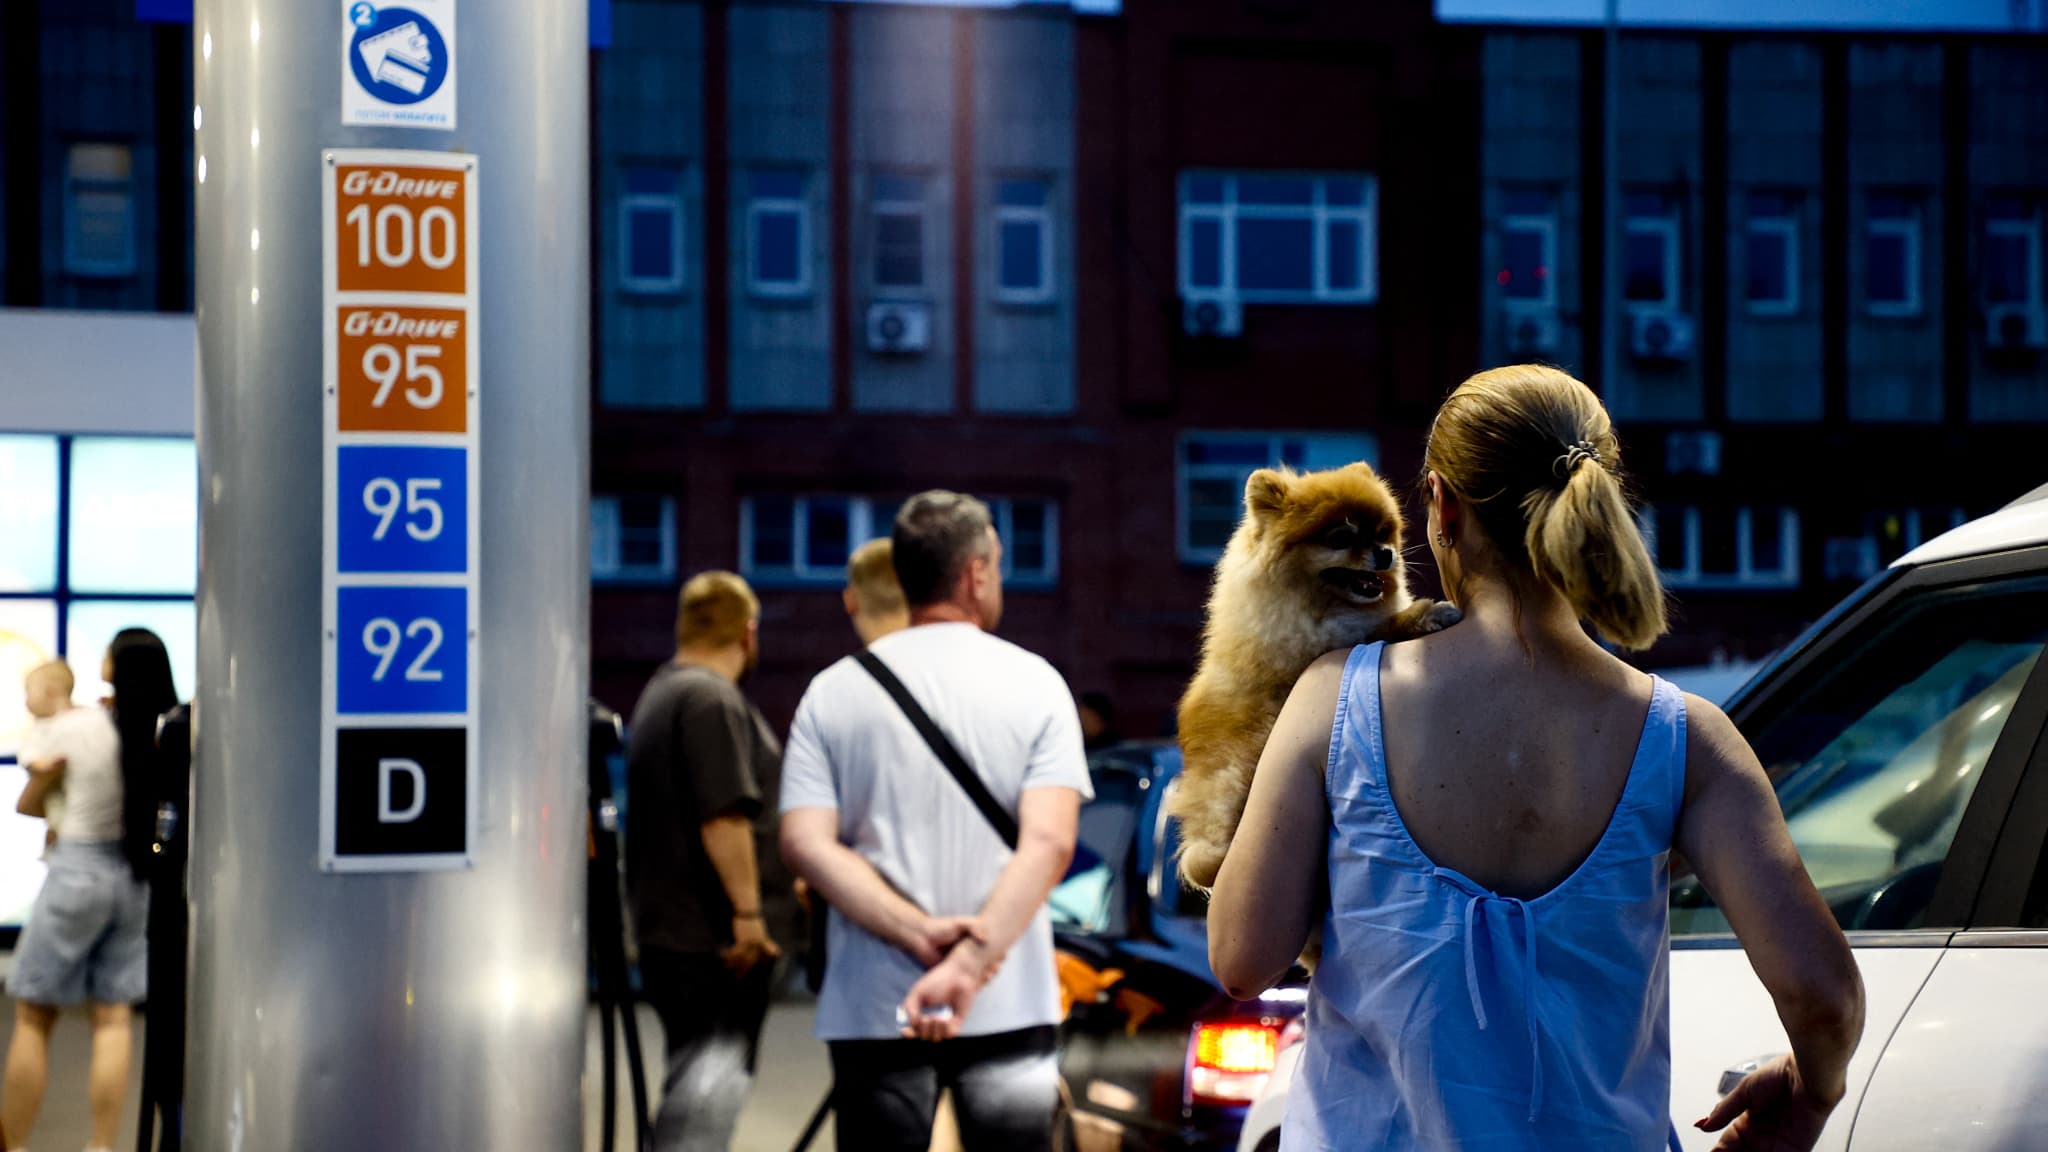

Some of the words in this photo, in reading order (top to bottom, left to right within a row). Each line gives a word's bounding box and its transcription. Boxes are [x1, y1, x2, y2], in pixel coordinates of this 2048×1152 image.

[355, 4, 371, 26] 2
[347, 204, 457, 269] 100
[362, 343, 443, 409] 95
[363, 478, 443, 540] 95
[362, 618, 443, 681] 92
[378, 759, 426, 823] D
